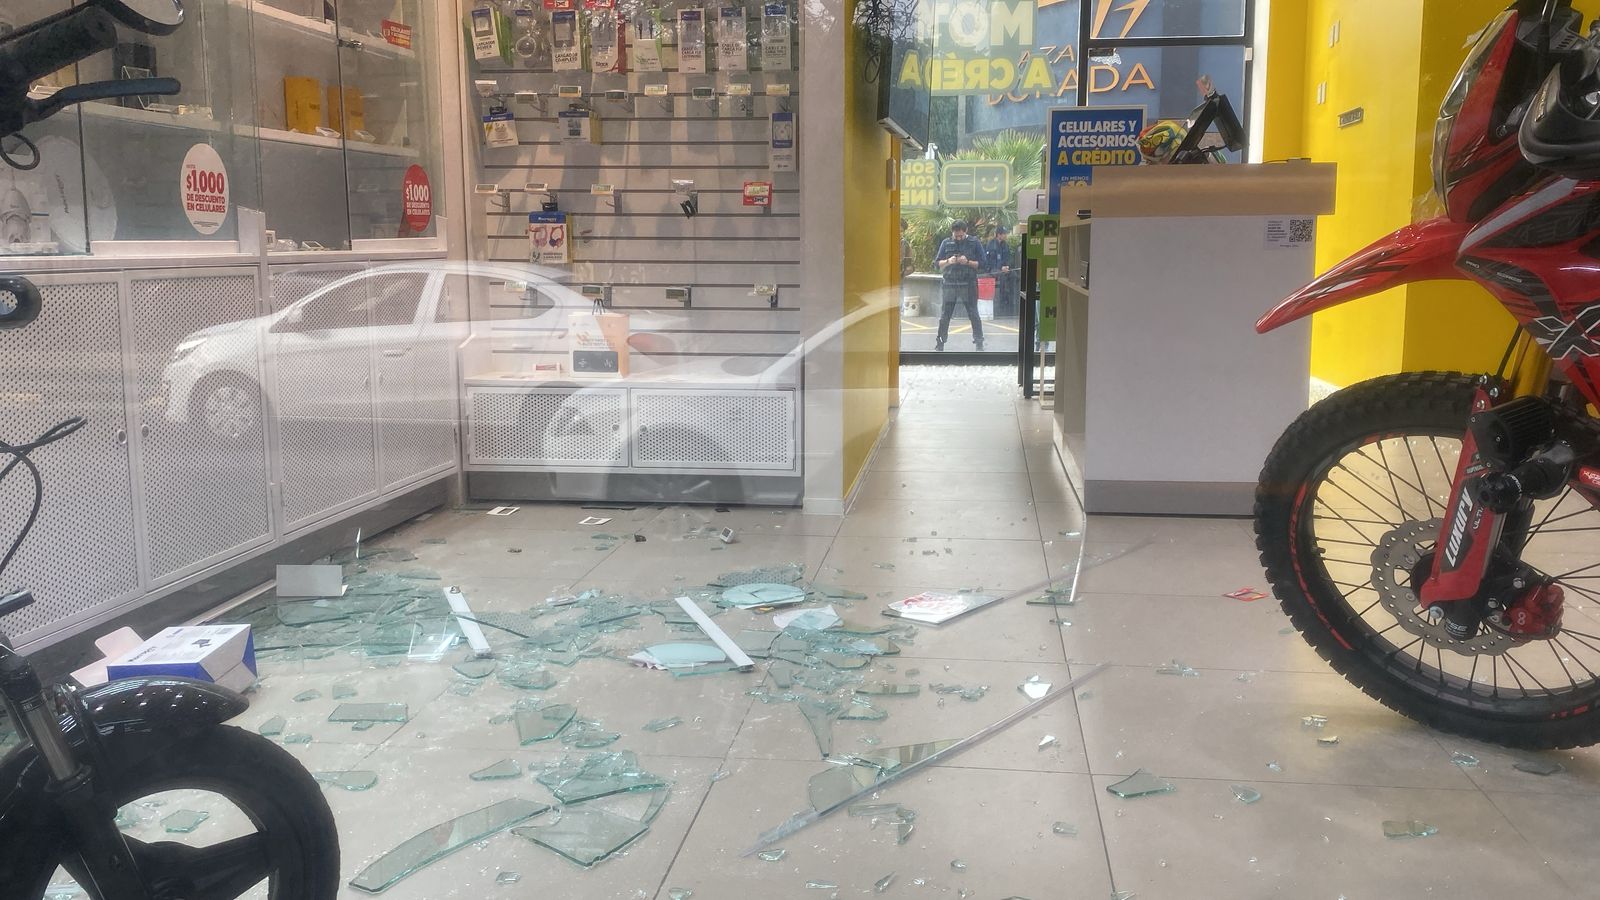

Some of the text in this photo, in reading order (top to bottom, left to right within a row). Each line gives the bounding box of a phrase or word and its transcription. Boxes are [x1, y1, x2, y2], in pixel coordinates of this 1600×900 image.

[1058, 120, 1137, 133] CELULARES Y
[1057, 134, 1137, 148] ACCESORIOS
[1057, 147, 1136, 165] A CRÉDITO
[187, 170, 225, 194] $1,000
[186, 193, 225, 204] DE DESCUENTO
[187, 203, 226, 213] EN CELULARES
